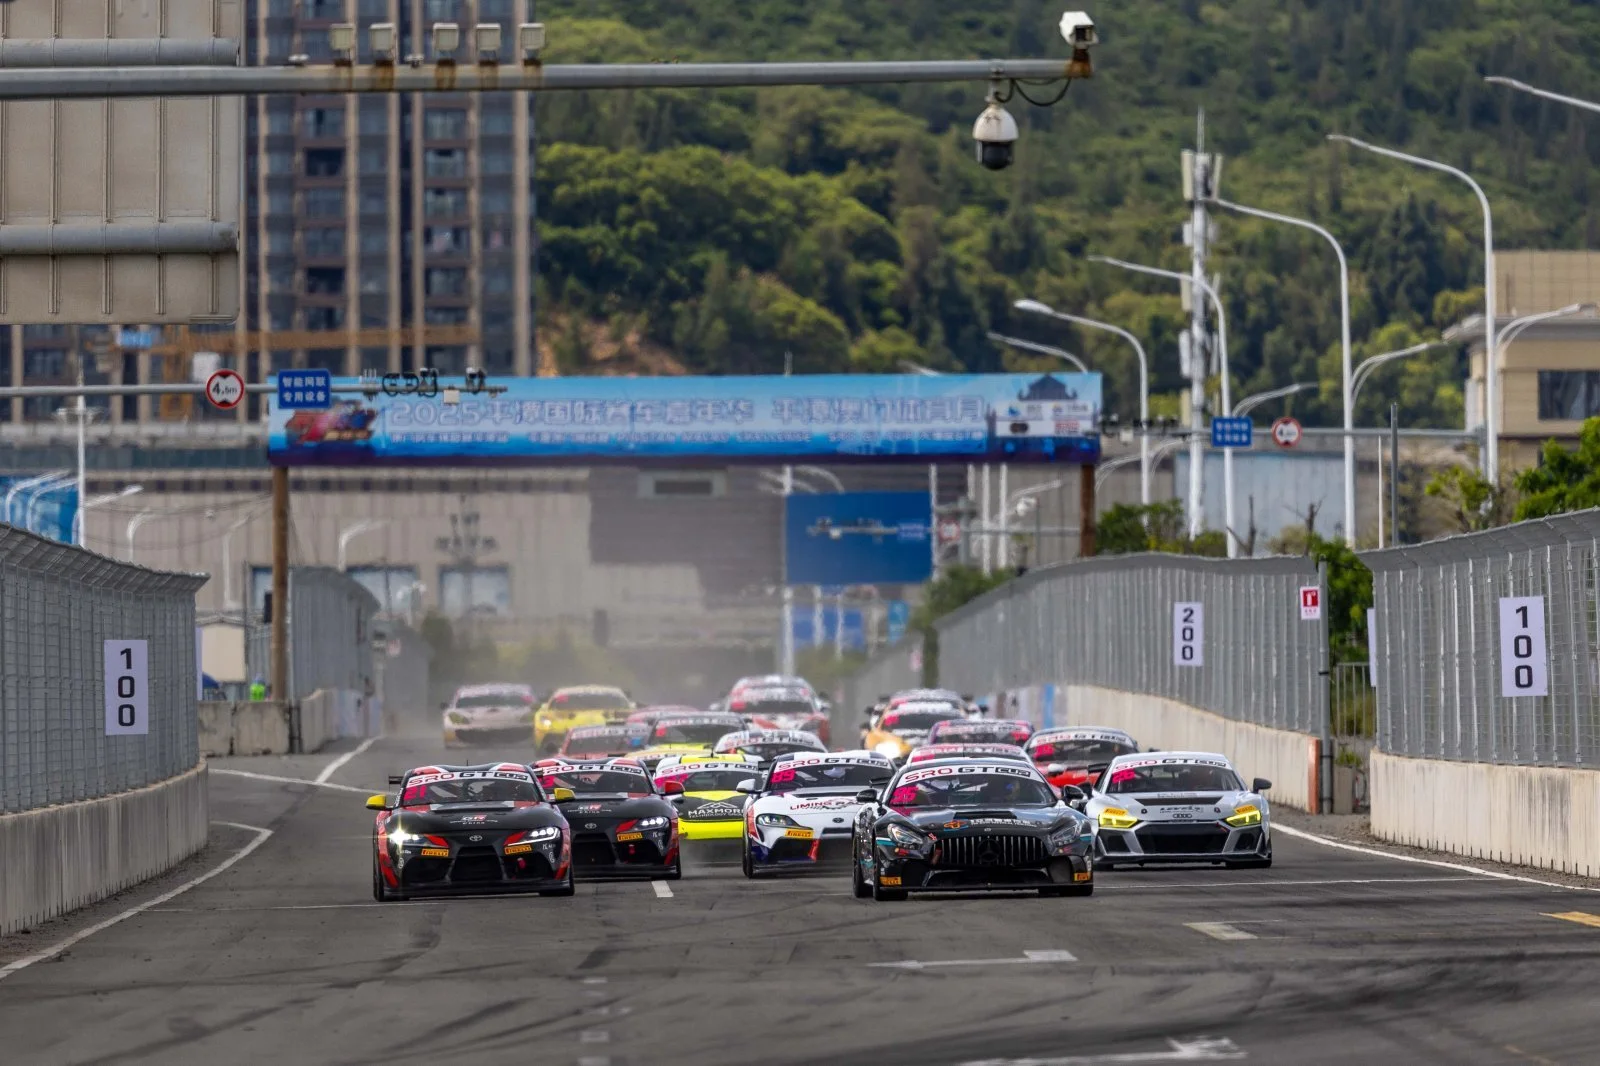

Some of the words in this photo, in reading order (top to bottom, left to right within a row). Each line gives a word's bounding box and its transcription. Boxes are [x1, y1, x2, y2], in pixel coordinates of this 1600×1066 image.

[283, 377, 326, 387] 智能网联
[283, 391, 326, 402] 专用设备
[1182, 607, 1194, 660] 200
[1514, 605, 1533, 689] 100
[118, 648, 135, 726] 100
[662, 763, 701, 774] SRO
[779, 758, 820, 770] SRO
[1115, 760, 1158, 770] SRO
[409, 773, 454, 785] SRO
[460, 771, 492, 779] GT
[905, 767, 953, 783] SRO
[404, 785, 427, 800] 21
[790, 801, 832, 811] LIMING
[688, 808, 744, 817] MAXMOR
